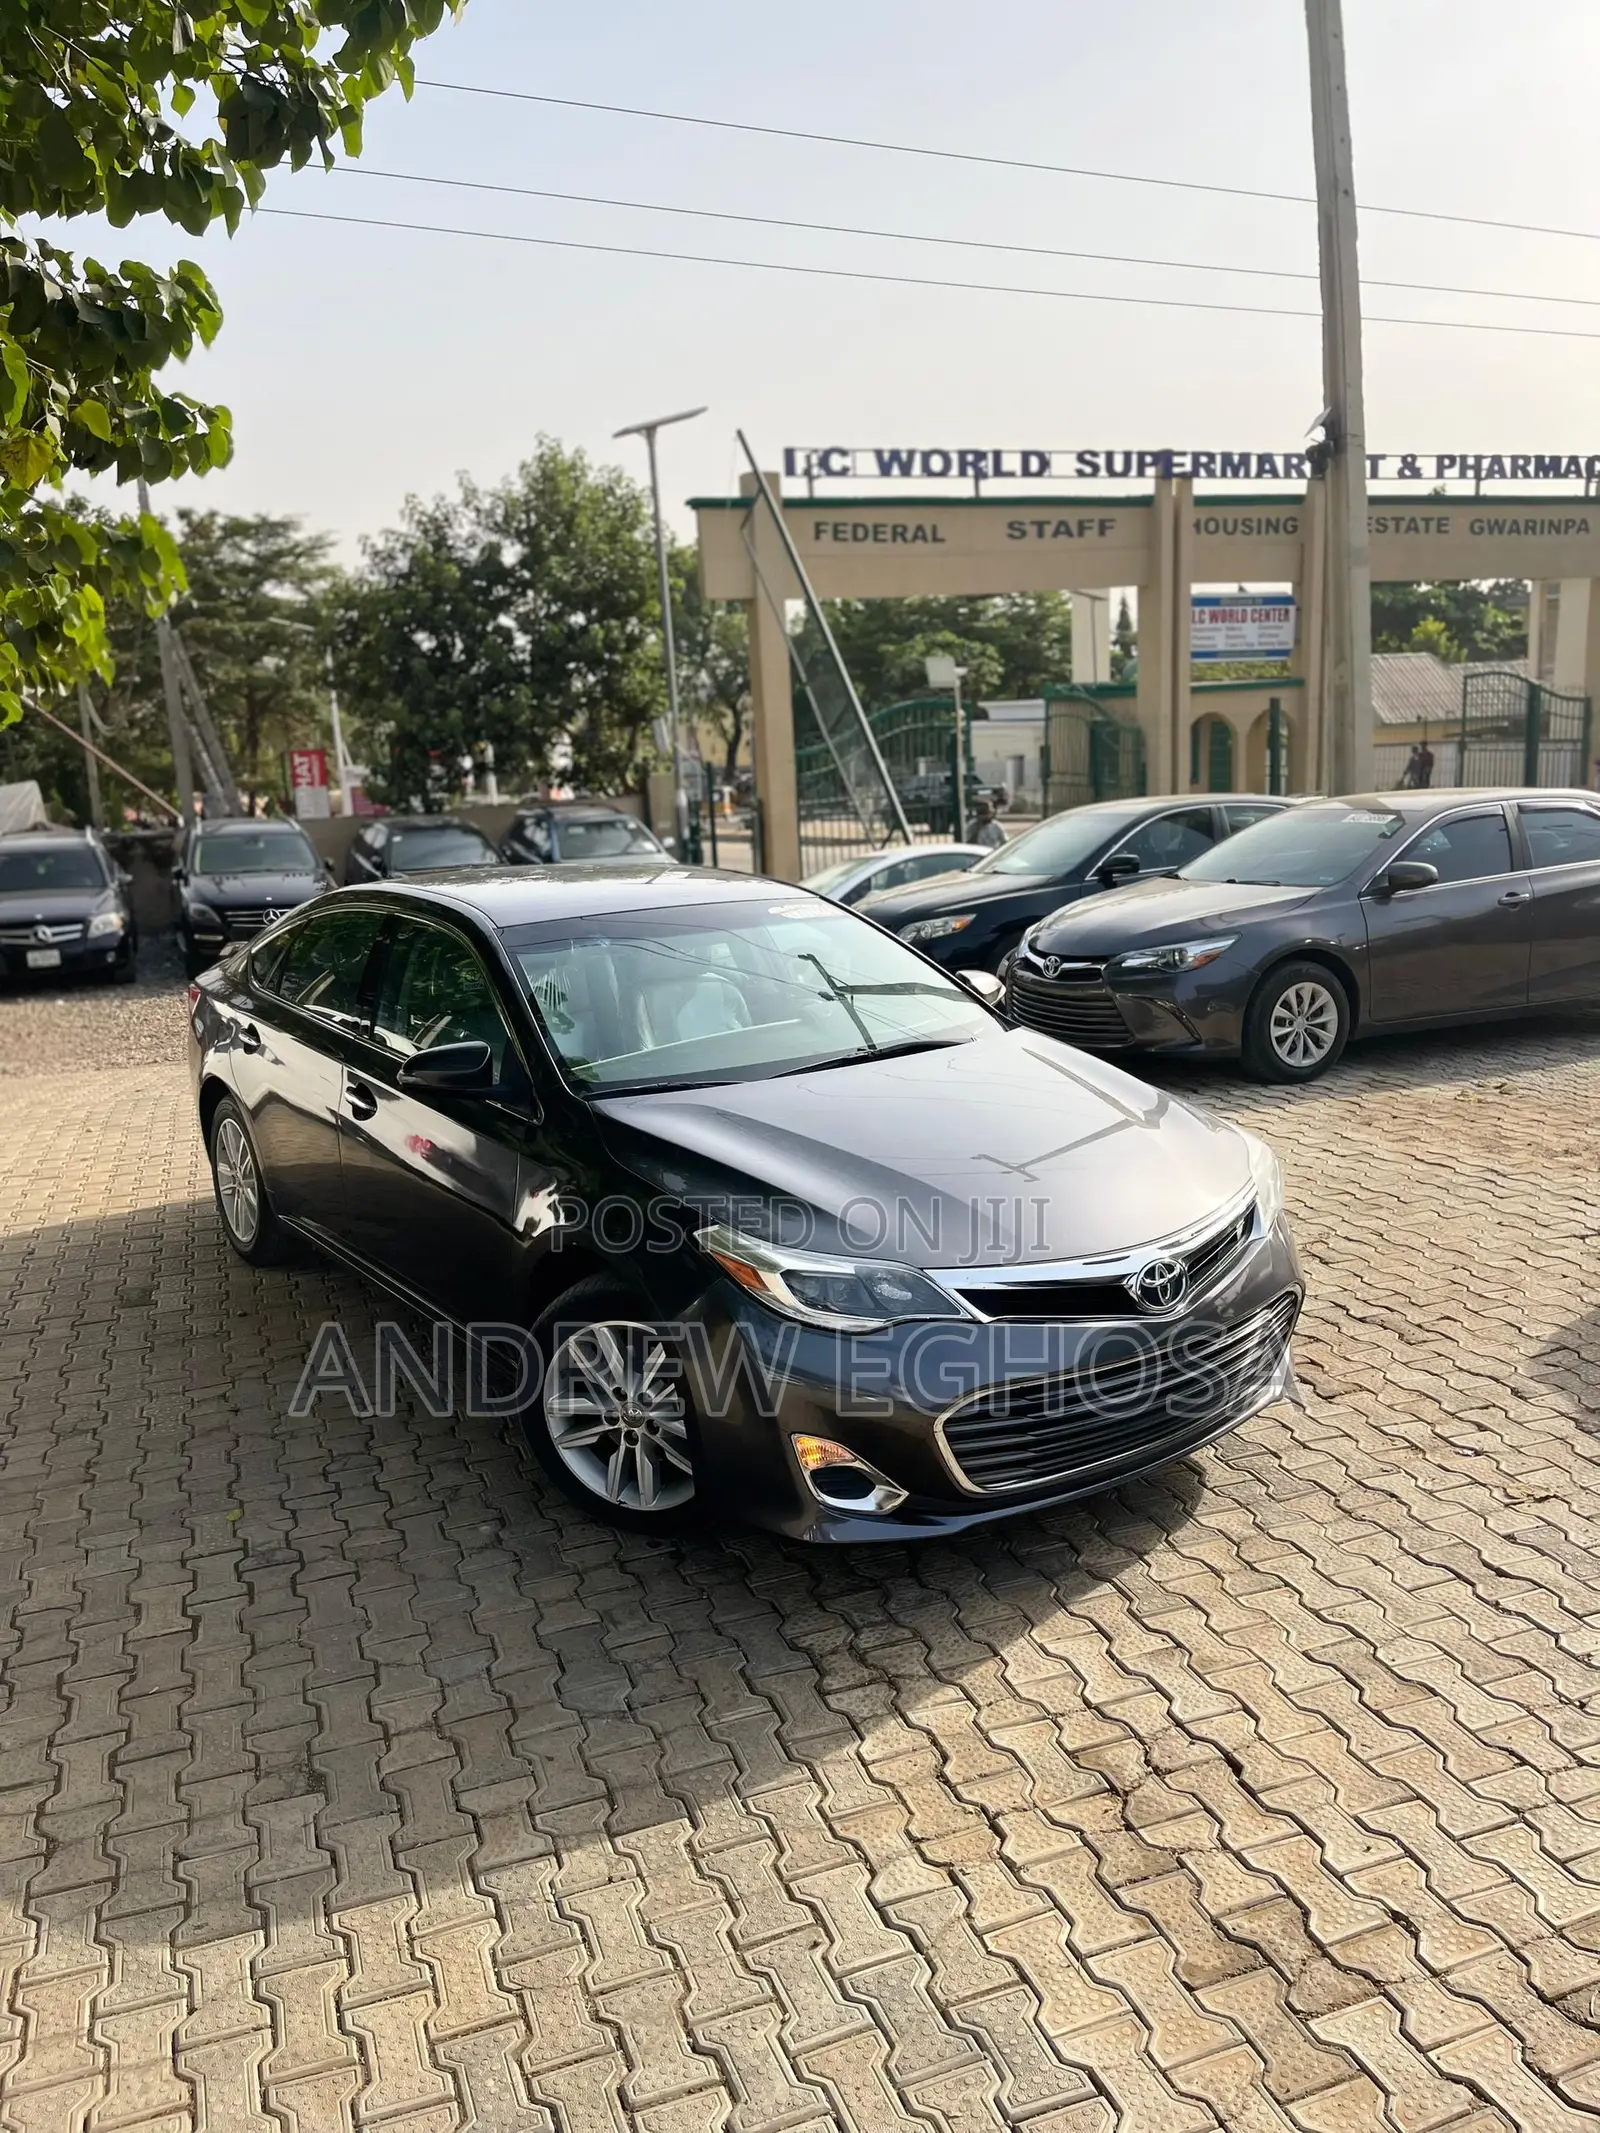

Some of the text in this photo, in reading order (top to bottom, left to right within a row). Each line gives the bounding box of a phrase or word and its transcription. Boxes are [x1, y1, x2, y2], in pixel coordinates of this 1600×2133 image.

[872, 448, 1050, 478] WORLD
[1074, 448, 1387, 479] SUPERMART
[1397, 453, 1423, 480] &
[813, 521, 946, 544] FEDERAL
[1005, 518, 1118, 540] STAFF
[1468, 517, 1591, 536] GWARINPA
[1208, 606, 1248, 624] WORLD
[1250, 606, 1290, 623] CENTER
